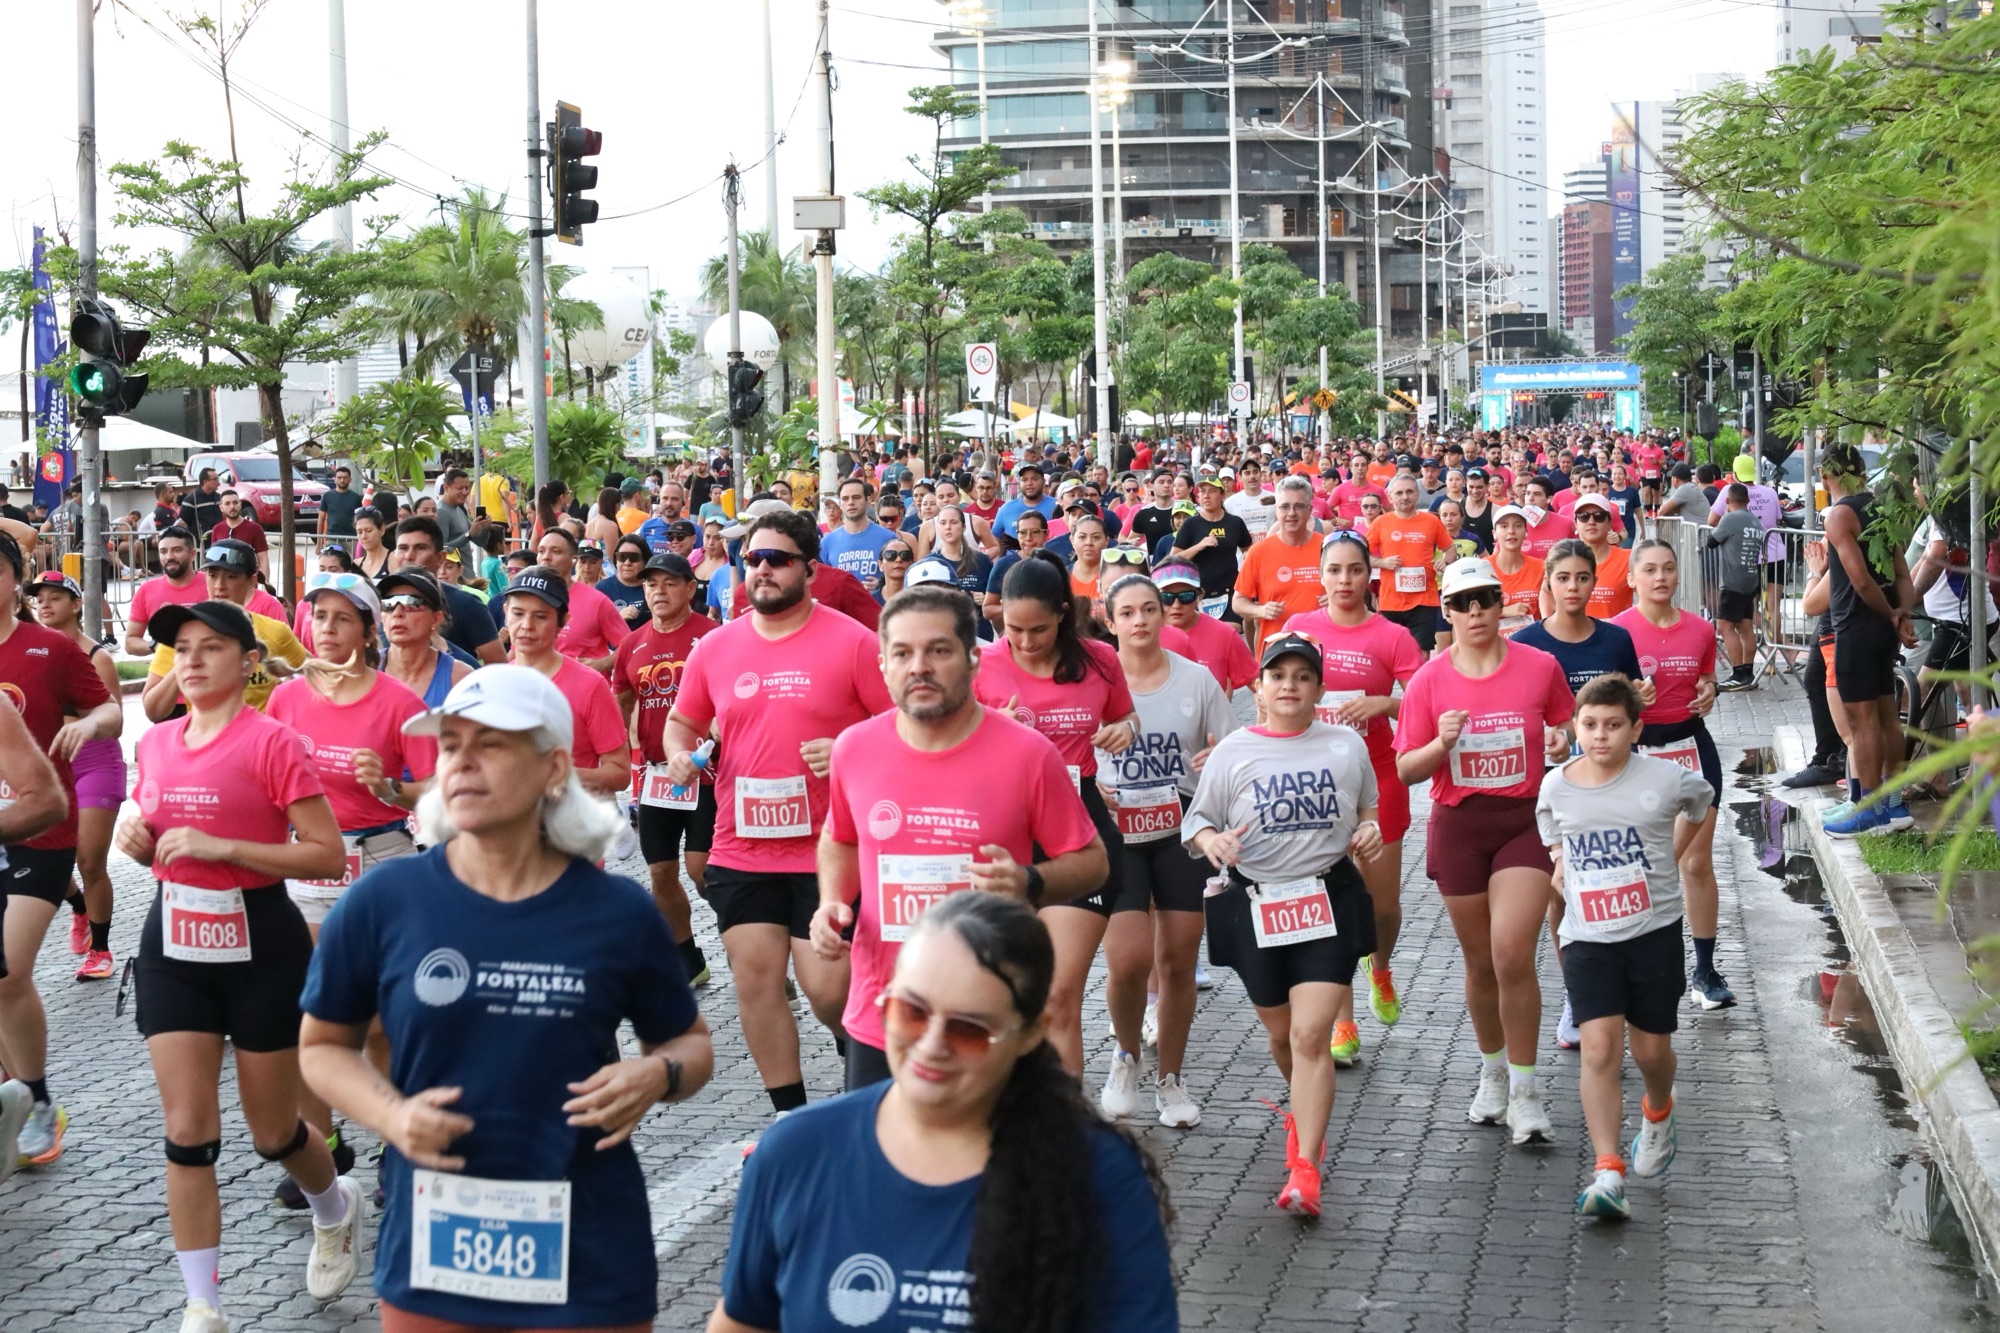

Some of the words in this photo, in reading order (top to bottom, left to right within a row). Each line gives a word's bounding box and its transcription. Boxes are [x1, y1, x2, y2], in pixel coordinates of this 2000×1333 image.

[624, 327, 650, 343] CEA
[838, 550, 874, 563] CORRIDA
[860, 561, 878, 575] 80
[520, 576, 548, 591] LIVE!
[1325, 652, 1372, 666] FORTALEZA
[1660, 660, 1699, 668] FORTALEZA
[762, 677, 811, 687] FORTALEZA
[1039, 713, 1092, 723] FORTALEZA
[1475, 717, 1525, 728] FORTALEZA
[316, 749, 352, 761] FORTAL
[1468, 754, 1518, 778] 12077
[1252, 768, 1337, 804] MARA
[162, 793, 220, 804] FORTALEZA
[750, 803, 800, 826] 10107
[906, 814, 980, 830] FORTALEZA
[1126, 810, 1175, 833] 10643
[1567, 826, 1645, 857] MARA
[902, 884, 947, 892] FRANCISCO
[892, 893, 946, 925] 107
[1285, 899, 1299, 907] ANA
[1589, 891, 1643, 921] 11443
[1268, 902, 1325, 933] 10142
[178, 918, 239, 948] 11608
[476, 971, 586, 993] FORTALEZA
[453, 1227, 537, 1278] 5848
[900, 1283, 971, 1307] FORTA
